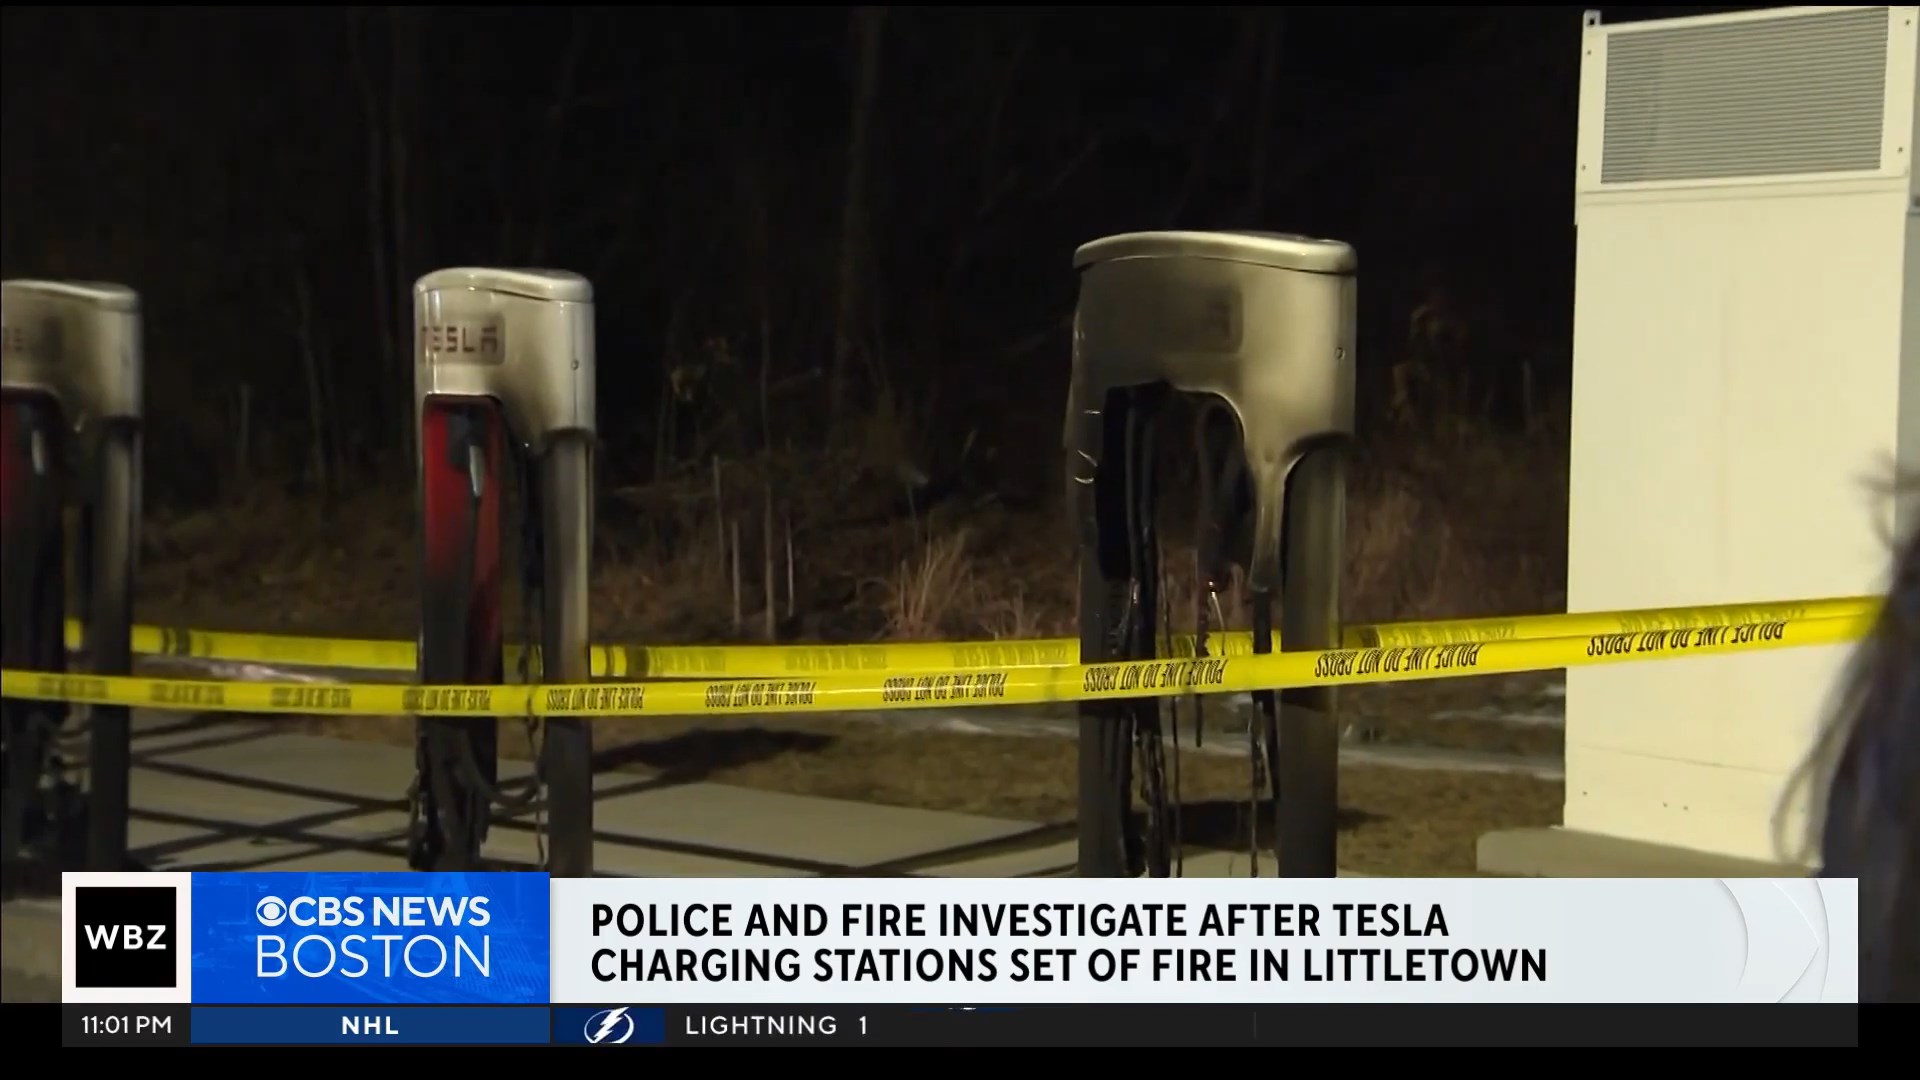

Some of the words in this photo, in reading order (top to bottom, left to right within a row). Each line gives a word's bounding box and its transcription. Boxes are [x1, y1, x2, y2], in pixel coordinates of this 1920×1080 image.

[1315, 651, 1359, 677] CROSS
[1356, 648, 1384, 674] NOT
[1384, 648, 1405, 672] DO
[1403, 646, 1436, 671] LINE
[1434, 643, 1484, 668] POLICE
[972, 673, 1008, 698] POLICE
[1083, 667, 1120, 692] CROSS
[1119, 665, 1144, 690] NOT
[1142, 664, 1162, 689] DO
[1160, 663, 1187, 688] LINE
[1185, 660, 1228, 686] POLICE
[883, 677, 915, 702] CROSS
[915, 676, 935, 700] NOT
[934, 675, 951, 700] DO
[950, 675, 973, 699] LINE
